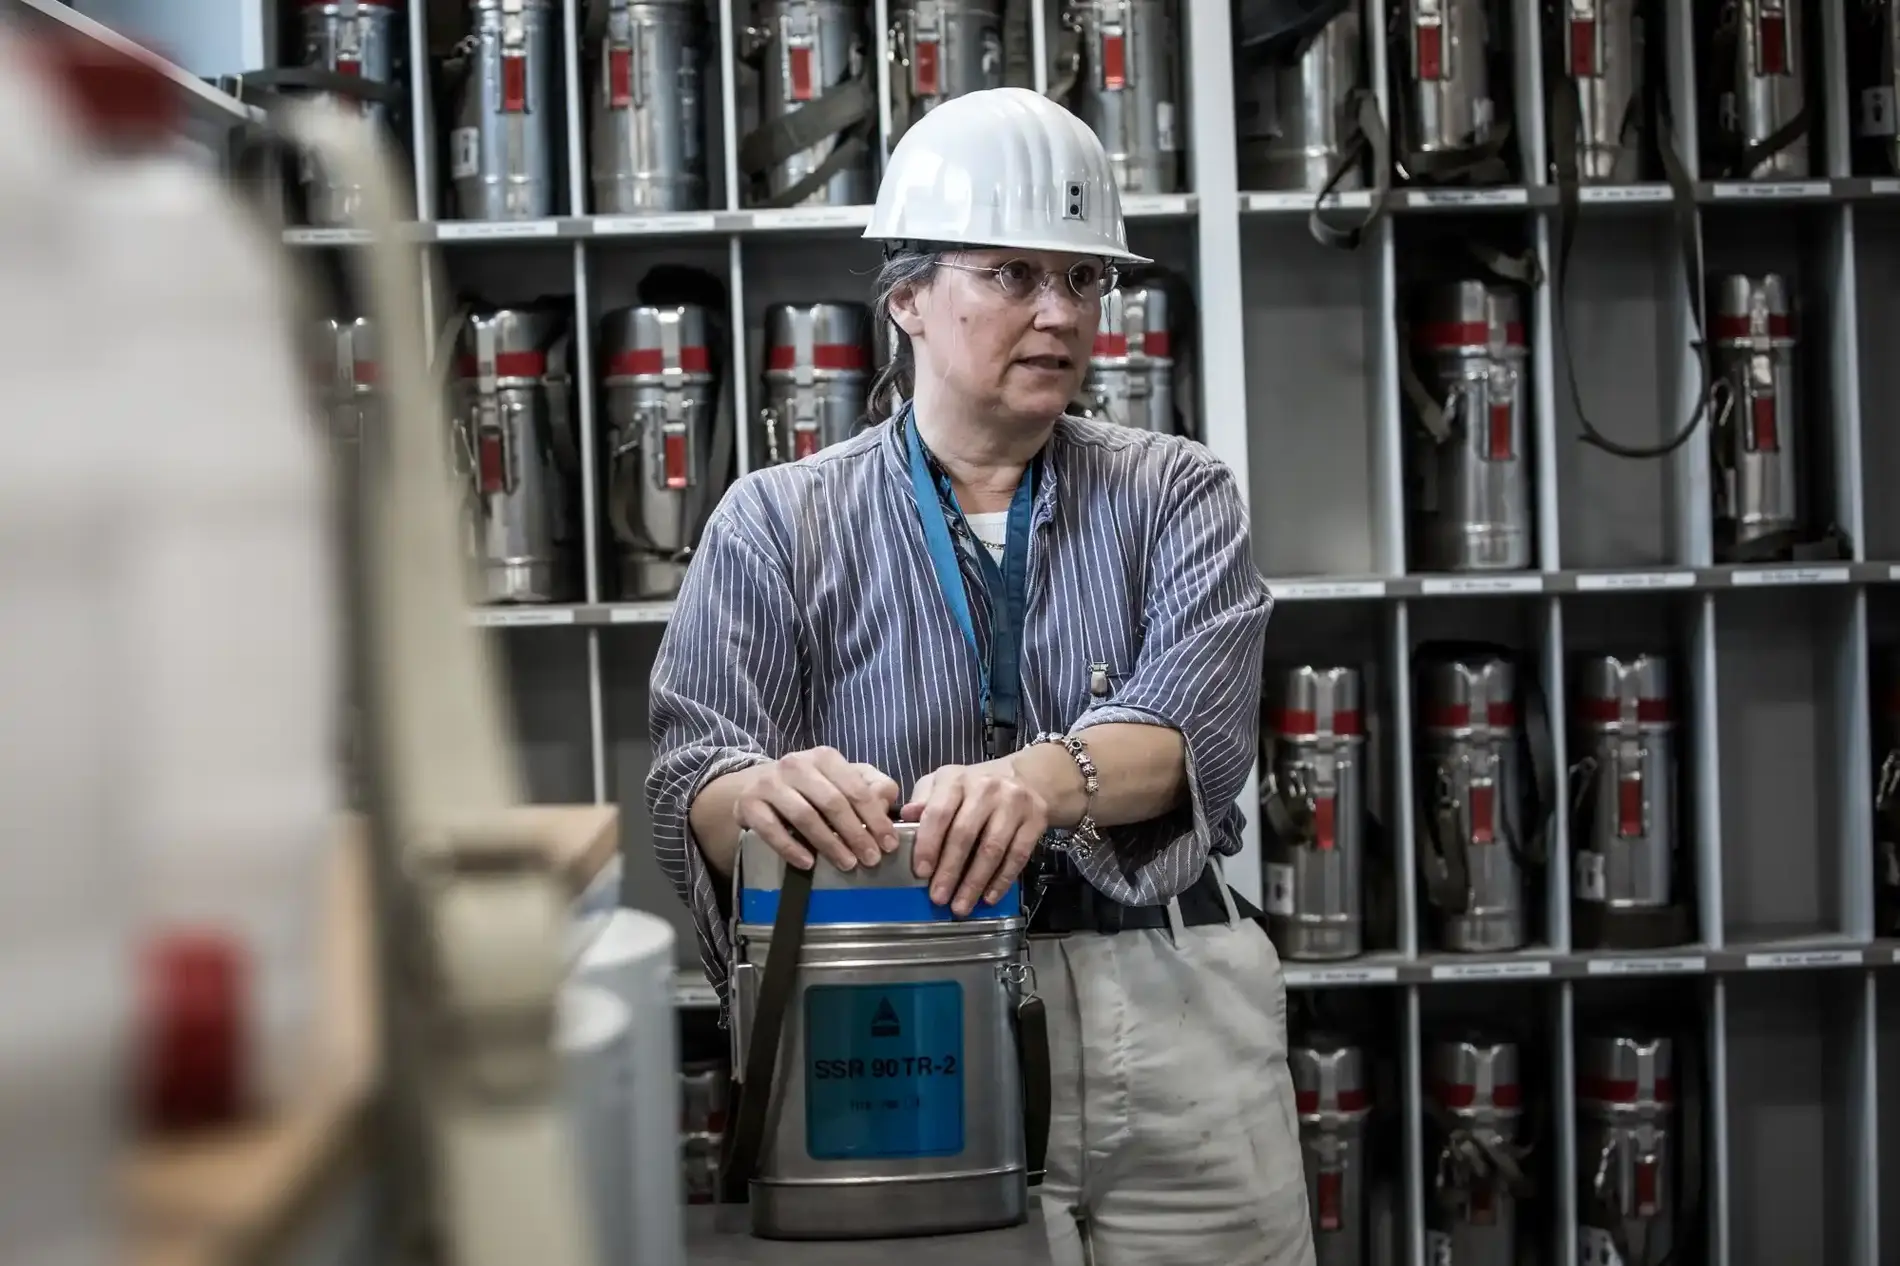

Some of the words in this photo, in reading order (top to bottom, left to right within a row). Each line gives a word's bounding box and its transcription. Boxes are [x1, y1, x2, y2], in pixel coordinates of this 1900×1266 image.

[815, 1058, 865, 1079] SSR
[871, 1057, 899, 1078] 90
[901, 1054, 956, 1077] TR-2
